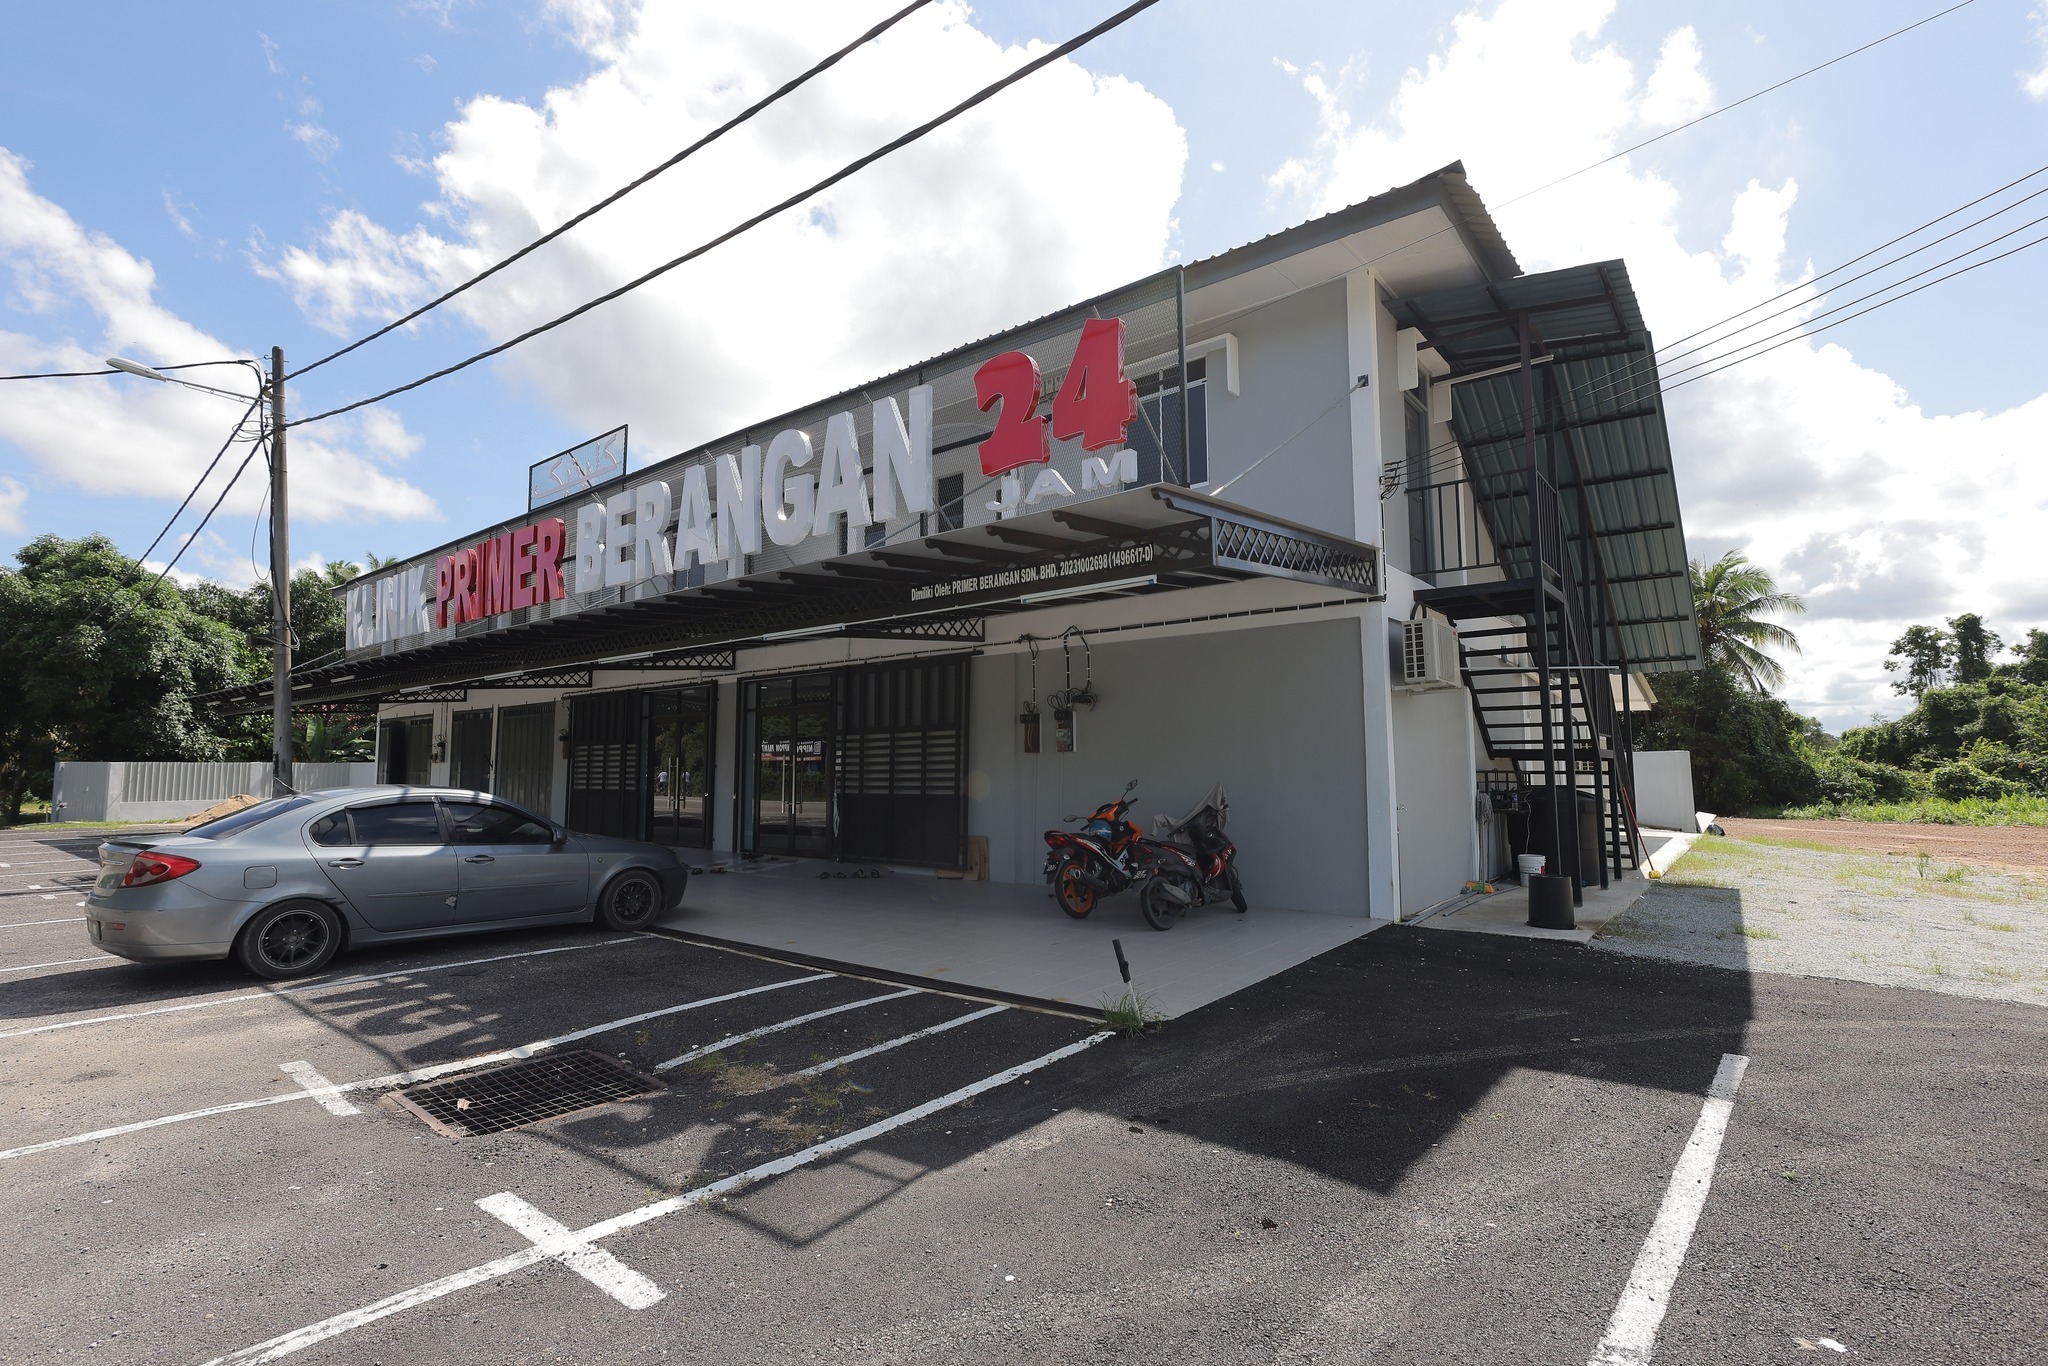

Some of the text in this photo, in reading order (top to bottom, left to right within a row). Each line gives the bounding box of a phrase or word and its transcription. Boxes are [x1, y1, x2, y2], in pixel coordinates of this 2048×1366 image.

[974, 317, 1137, 478] 24
[345, 384, 933, 651] KLINIK PRIMER BERANGAN
[985, 448, 1138, 511] JAM
[911, 585, 934, 601] Dimiliki
[934, 582, 951, 597] Oleh:
[952, 577, 978, 594] PRIMER
[980, 570, 1020, 590] BERANGAN
[1021, 567, 1039, 583] SDN.
[1040, 563, 1059, 580] BHD.
